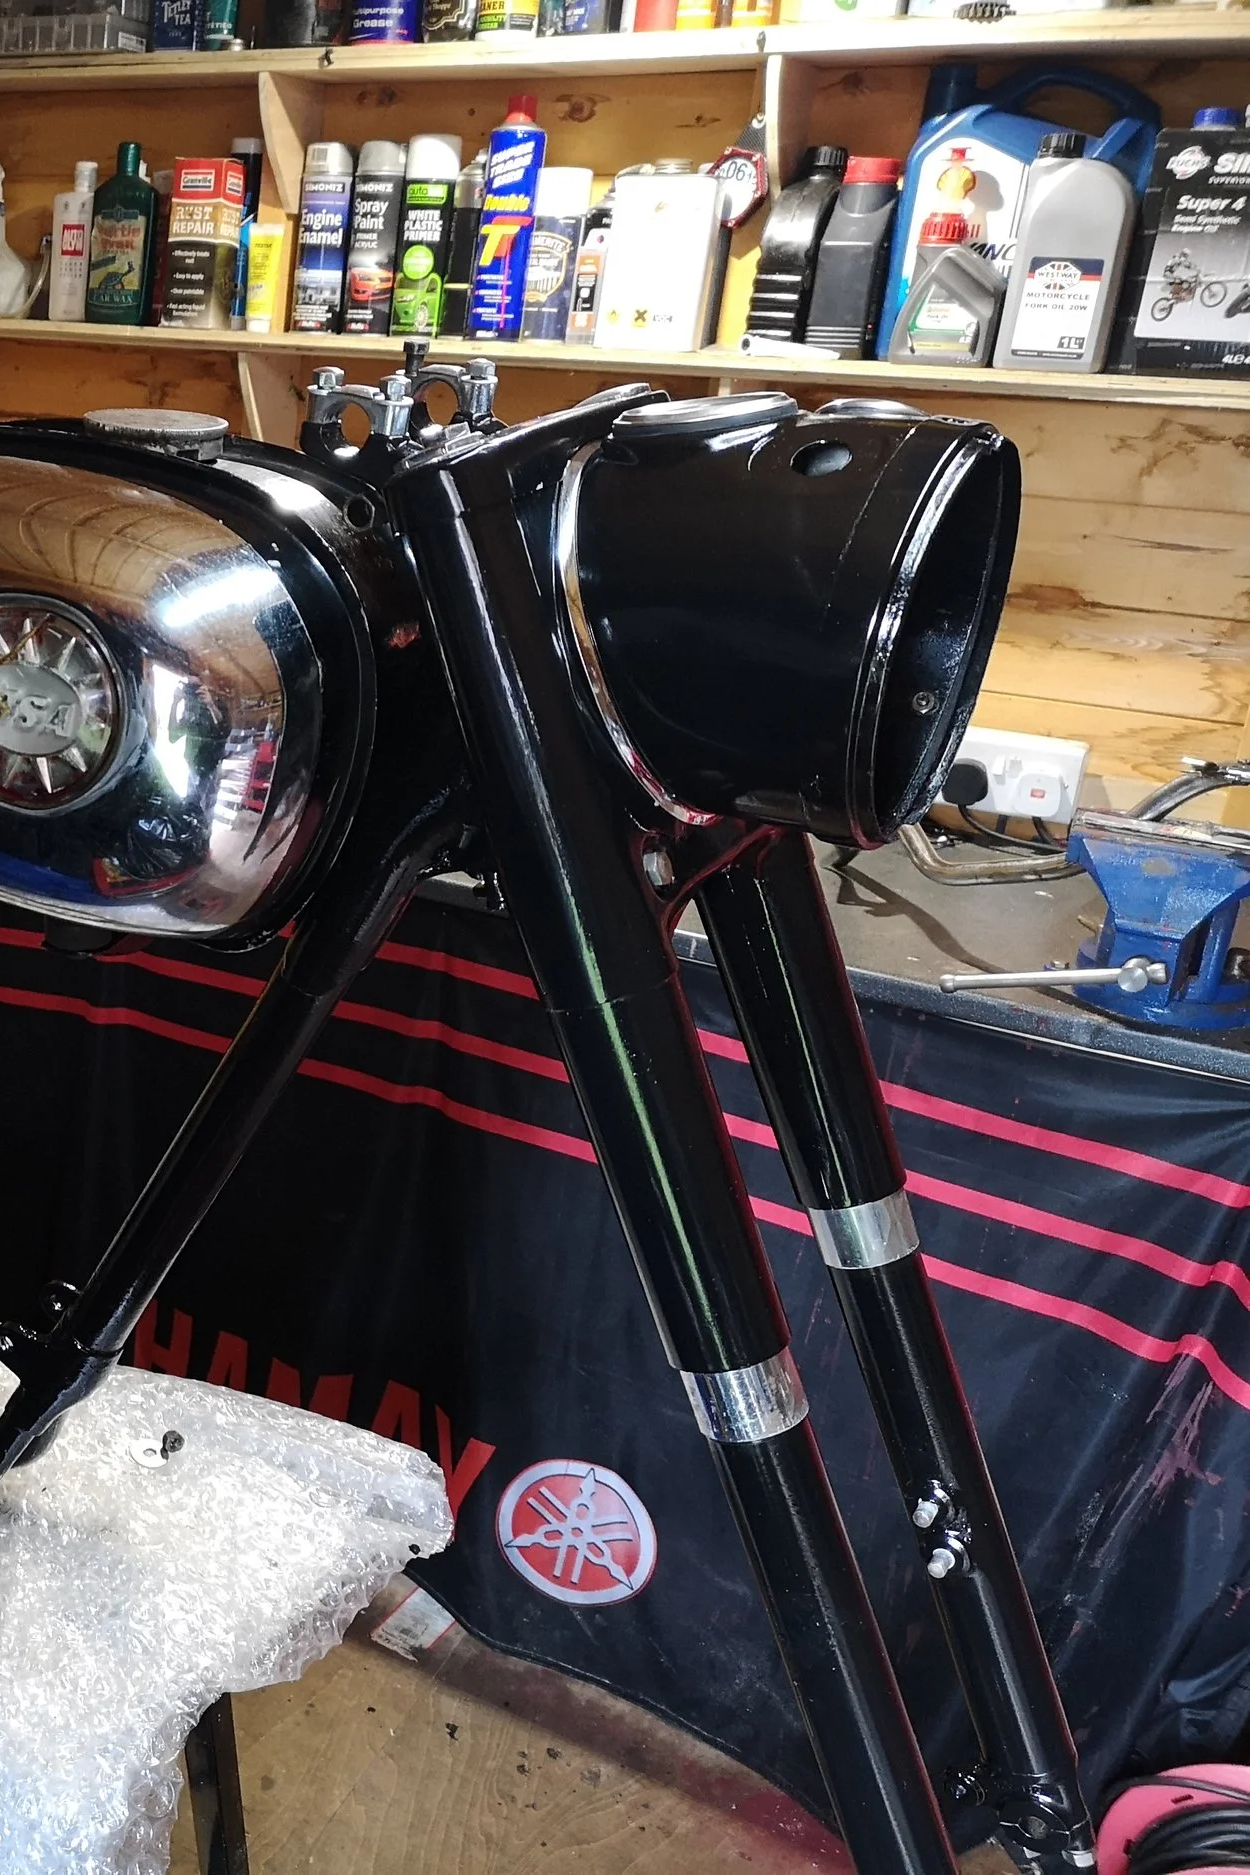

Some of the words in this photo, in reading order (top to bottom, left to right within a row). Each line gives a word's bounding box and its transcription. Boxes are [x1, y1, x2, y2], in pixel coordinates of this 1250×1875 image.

[175, 13, 191, 25] TEA
[352, 18, 394, 28] Grease
[304, 183, 344, 192] SIMONIZ
[355, 183, 394, 192] SIMONIZ
[355, 198, 389, 215] Spray
[1176, 195, 1232, 213] Super
[1231, 196, 1247, 211] 4
[176, 206, 213, 220] RUST
[408, 210, 441, 221] WHITE
[302, 209, 342, 230] Engine
[355, 215, 384, 230] Paint
[403, 220, 443, 231] PLASTIC
[172, 221, 214, 235] REPAIR
[300, 228, 343, 248] Enamel
[403, 231, 441, 242] PRIMER
[1027, 292, 1090, 301] MOTORCYCLE
